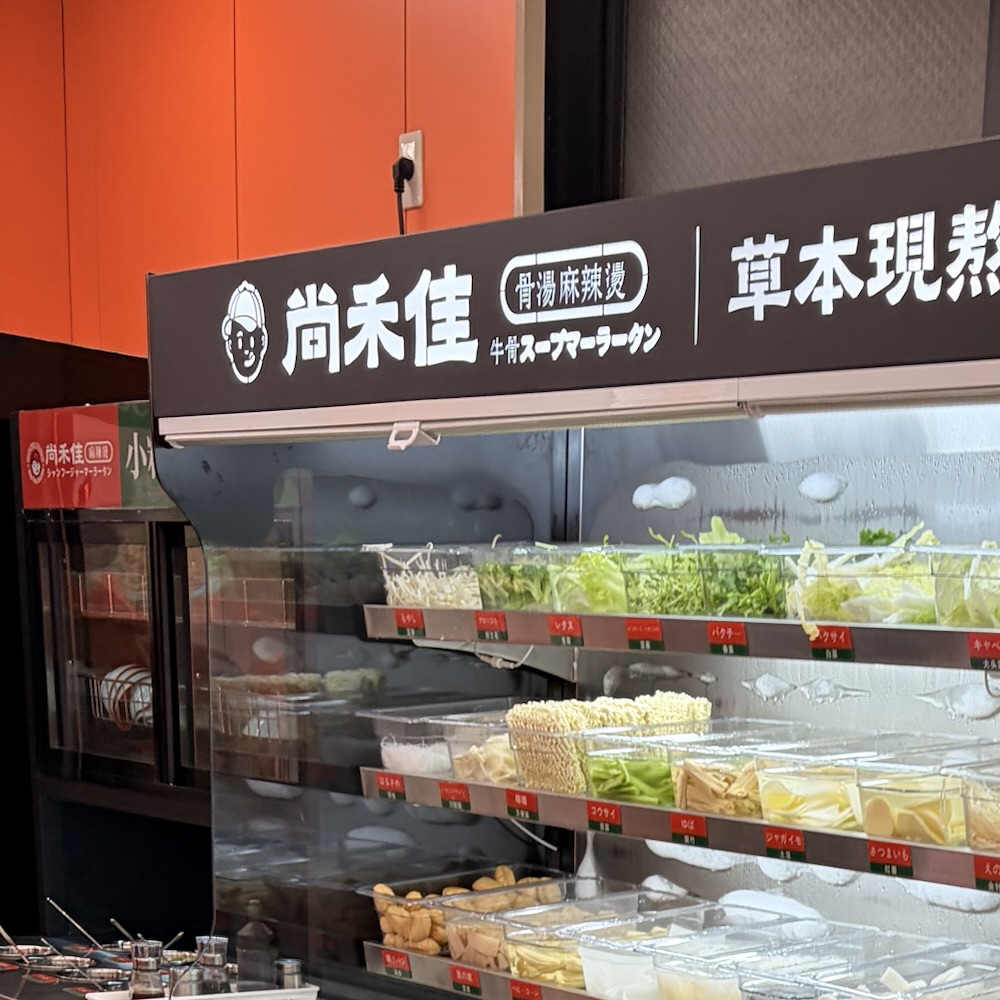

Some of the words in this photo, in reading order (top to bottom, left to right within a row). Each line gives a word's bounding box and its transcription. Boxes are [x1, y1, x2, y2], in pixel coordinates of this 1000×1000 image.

[282, 264, 479, 375] 尚禾佳
[45, 442, 85, 466] 尚禾佳
[555, 620, 574, 631] レタス
[766, 832, 801, 847] ジャガイモ
[870, 845, 910, 862] さつまいも
